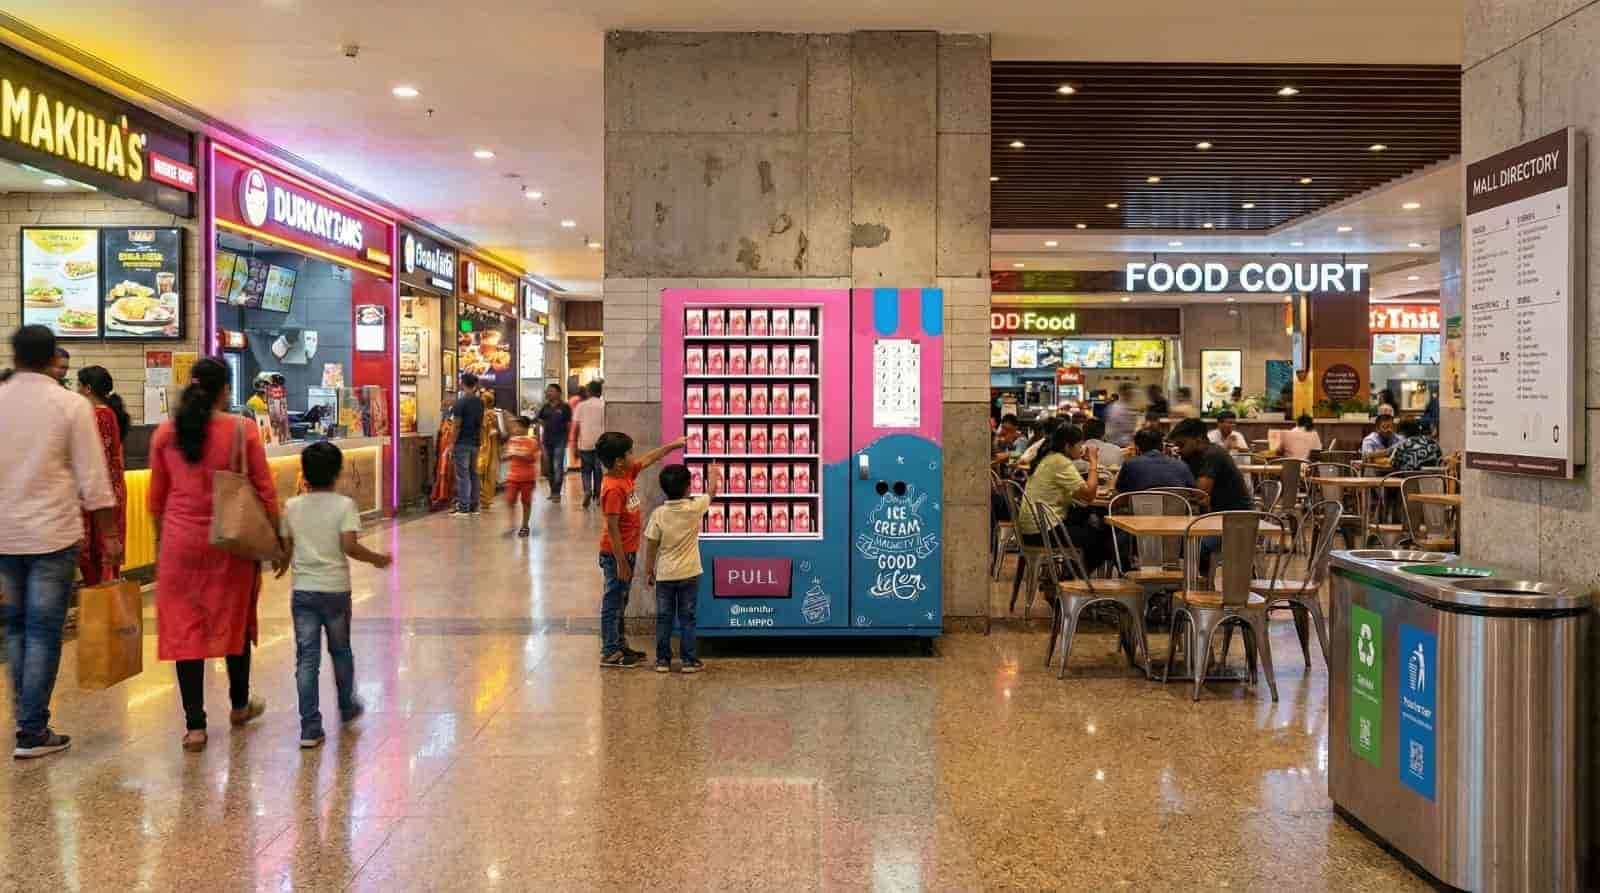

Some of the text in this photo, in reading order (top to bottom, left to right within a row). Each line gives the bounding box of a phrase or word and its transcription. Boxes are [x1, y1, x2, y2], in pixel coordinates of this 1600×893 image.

[1473, 150, 1560, 196] MALL DIRECTORY
[1126, 262, 1369, 292] FOOD COURT
[1024, 312, 1075, 331] Food
[887, 506, 907, 519] ICE
[874, 519, 921, 536] CREAM
[878, 554, 917, 569] GOOD
[728, 569, 778, 585] PULL
